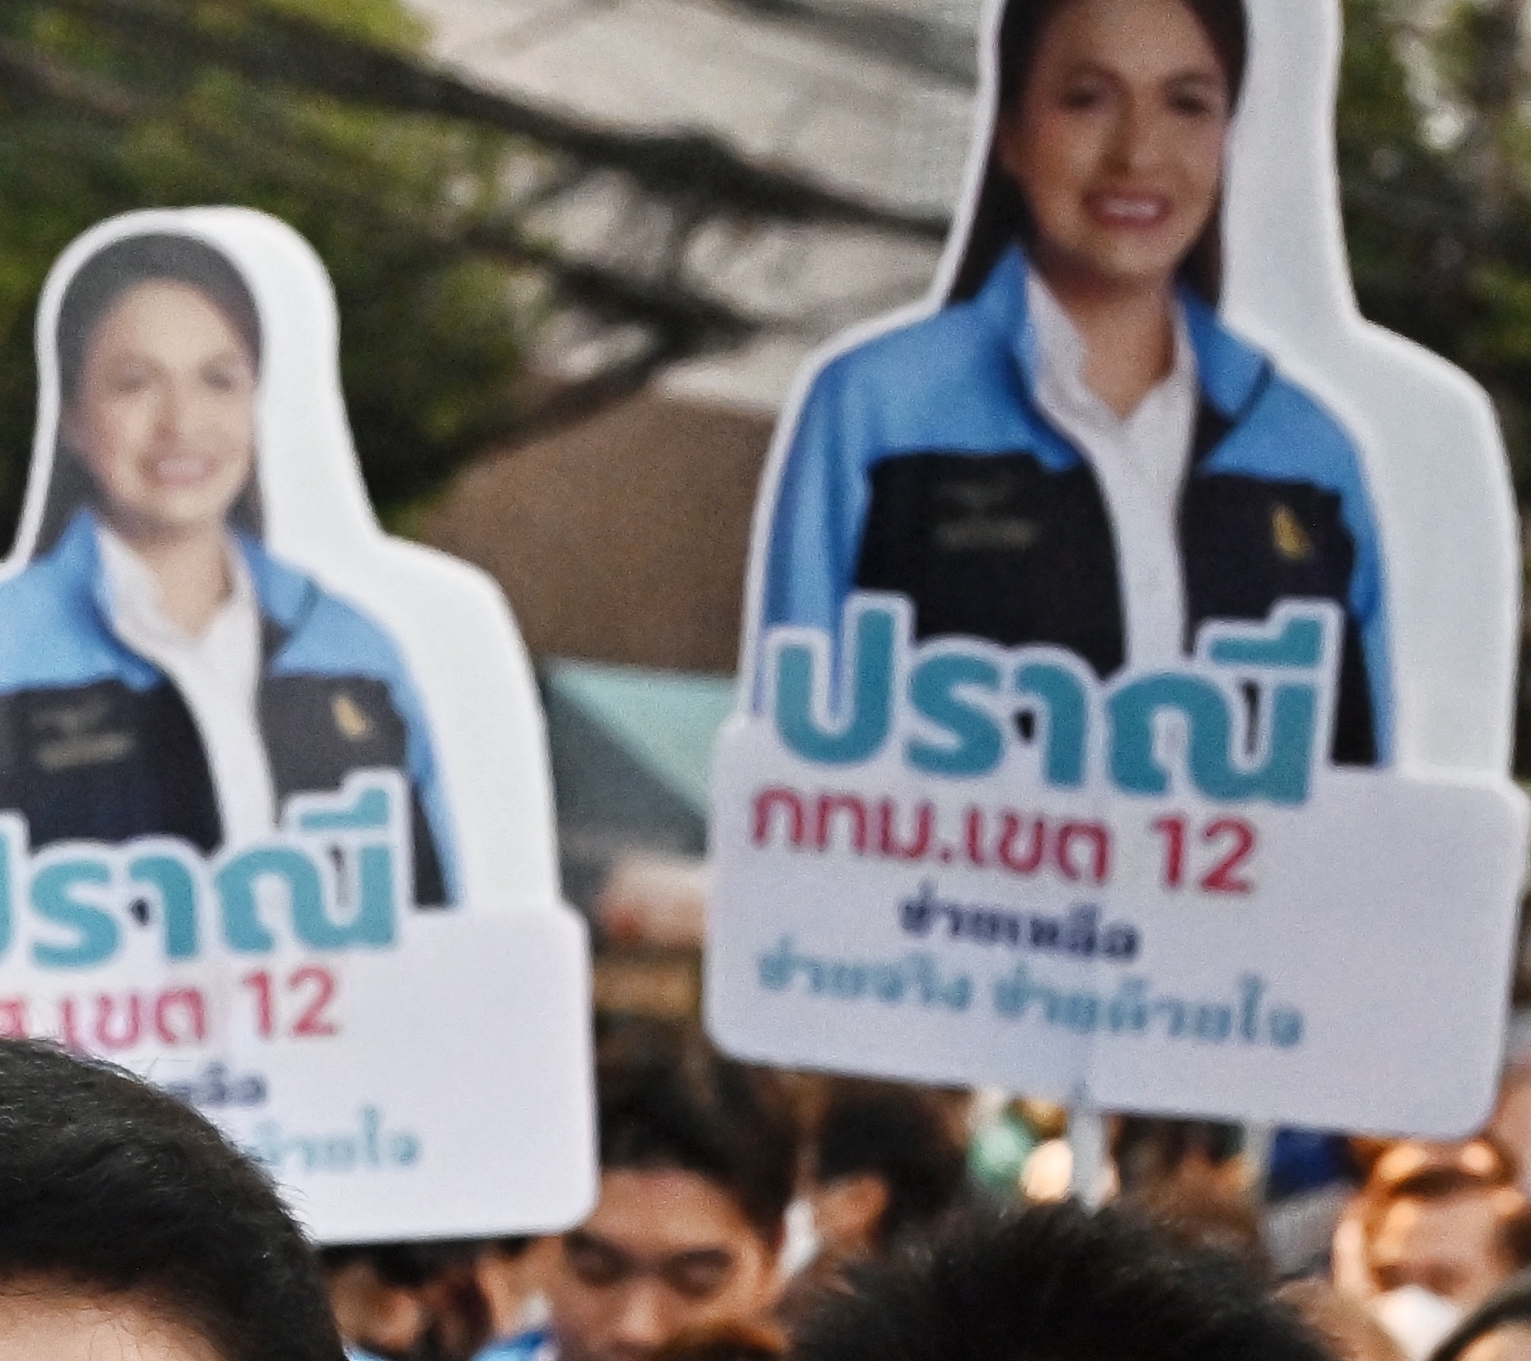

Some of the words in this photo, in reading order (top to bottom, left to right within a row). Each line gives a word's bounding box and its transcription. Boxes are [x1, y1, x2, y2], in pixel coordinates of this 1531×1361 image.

[774, 606, 1325, 806] ปราณี
[1150, 812, 1256, 895] 12
[240, 966, 340, 1040] 12
